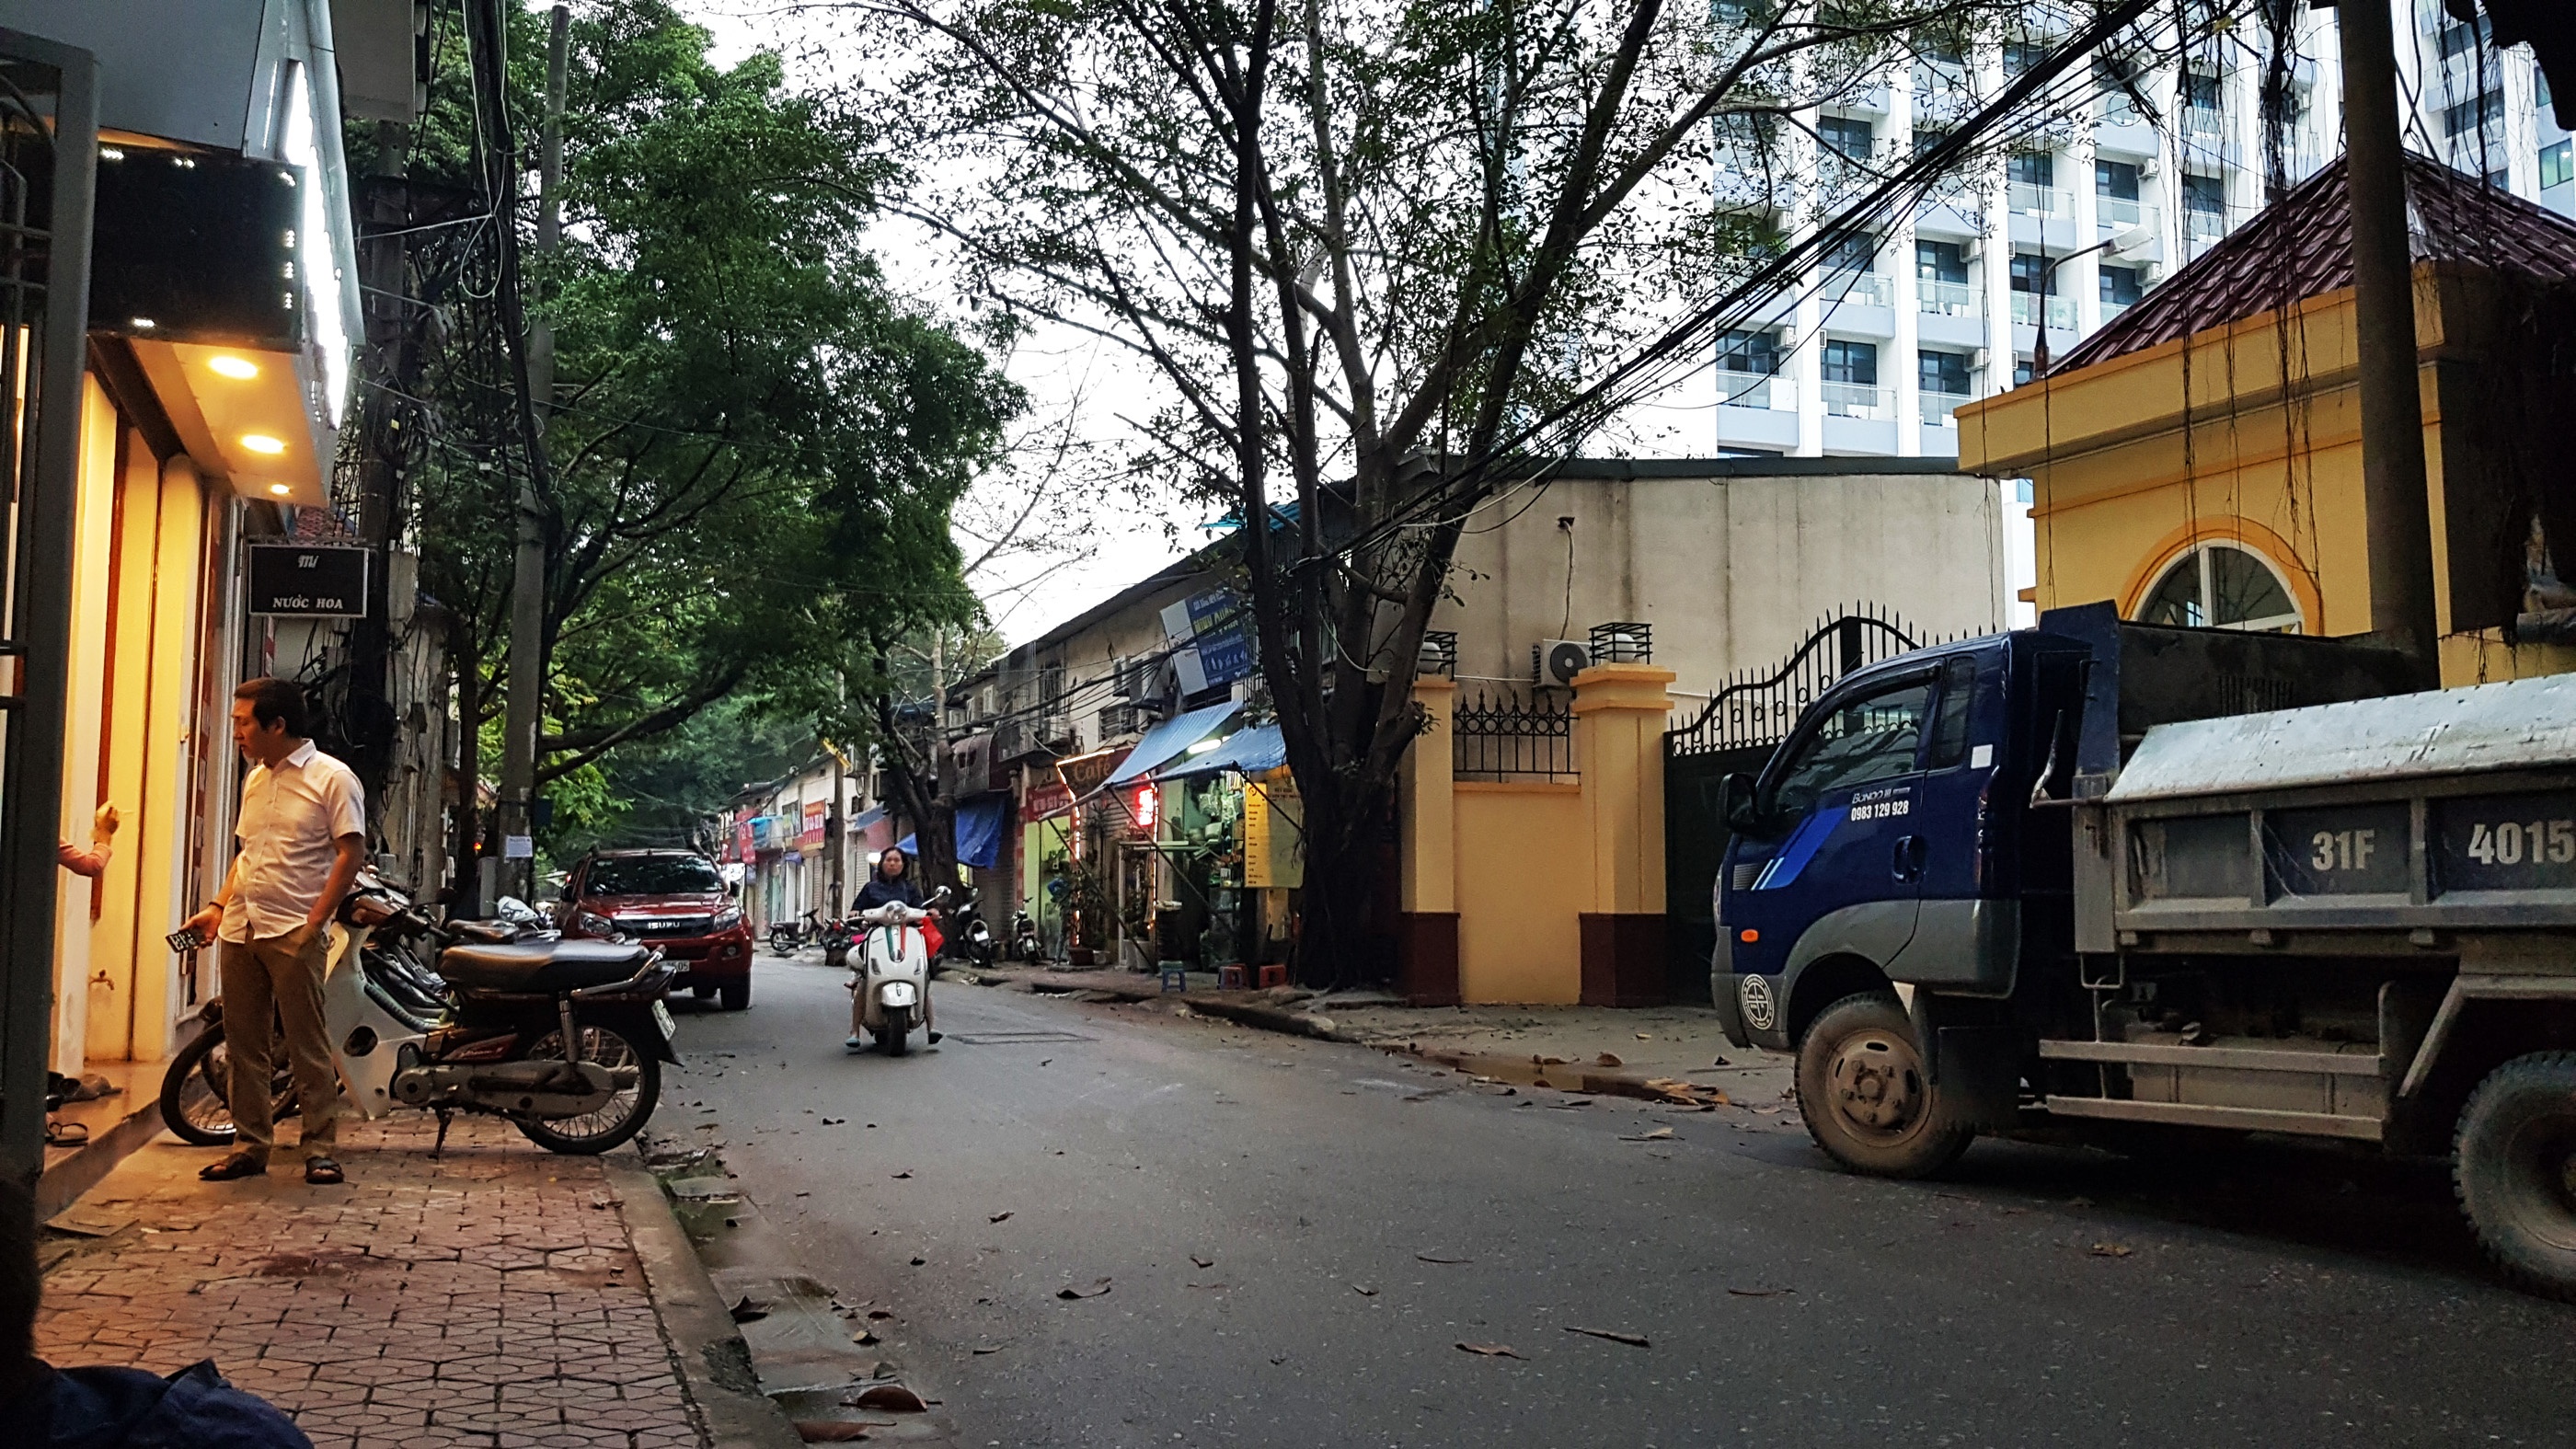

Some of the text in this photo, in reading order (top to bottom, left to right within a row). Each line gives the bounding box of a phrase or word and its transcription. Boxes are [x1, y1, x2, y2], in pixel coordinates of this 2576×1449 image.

[316, 598, 343, 609] HOA
[1075, 757, 1111, 781] Café
[1851, 799, 1909, 822] 0983 129 928
[2312, 829, 2375, 870] 31F
